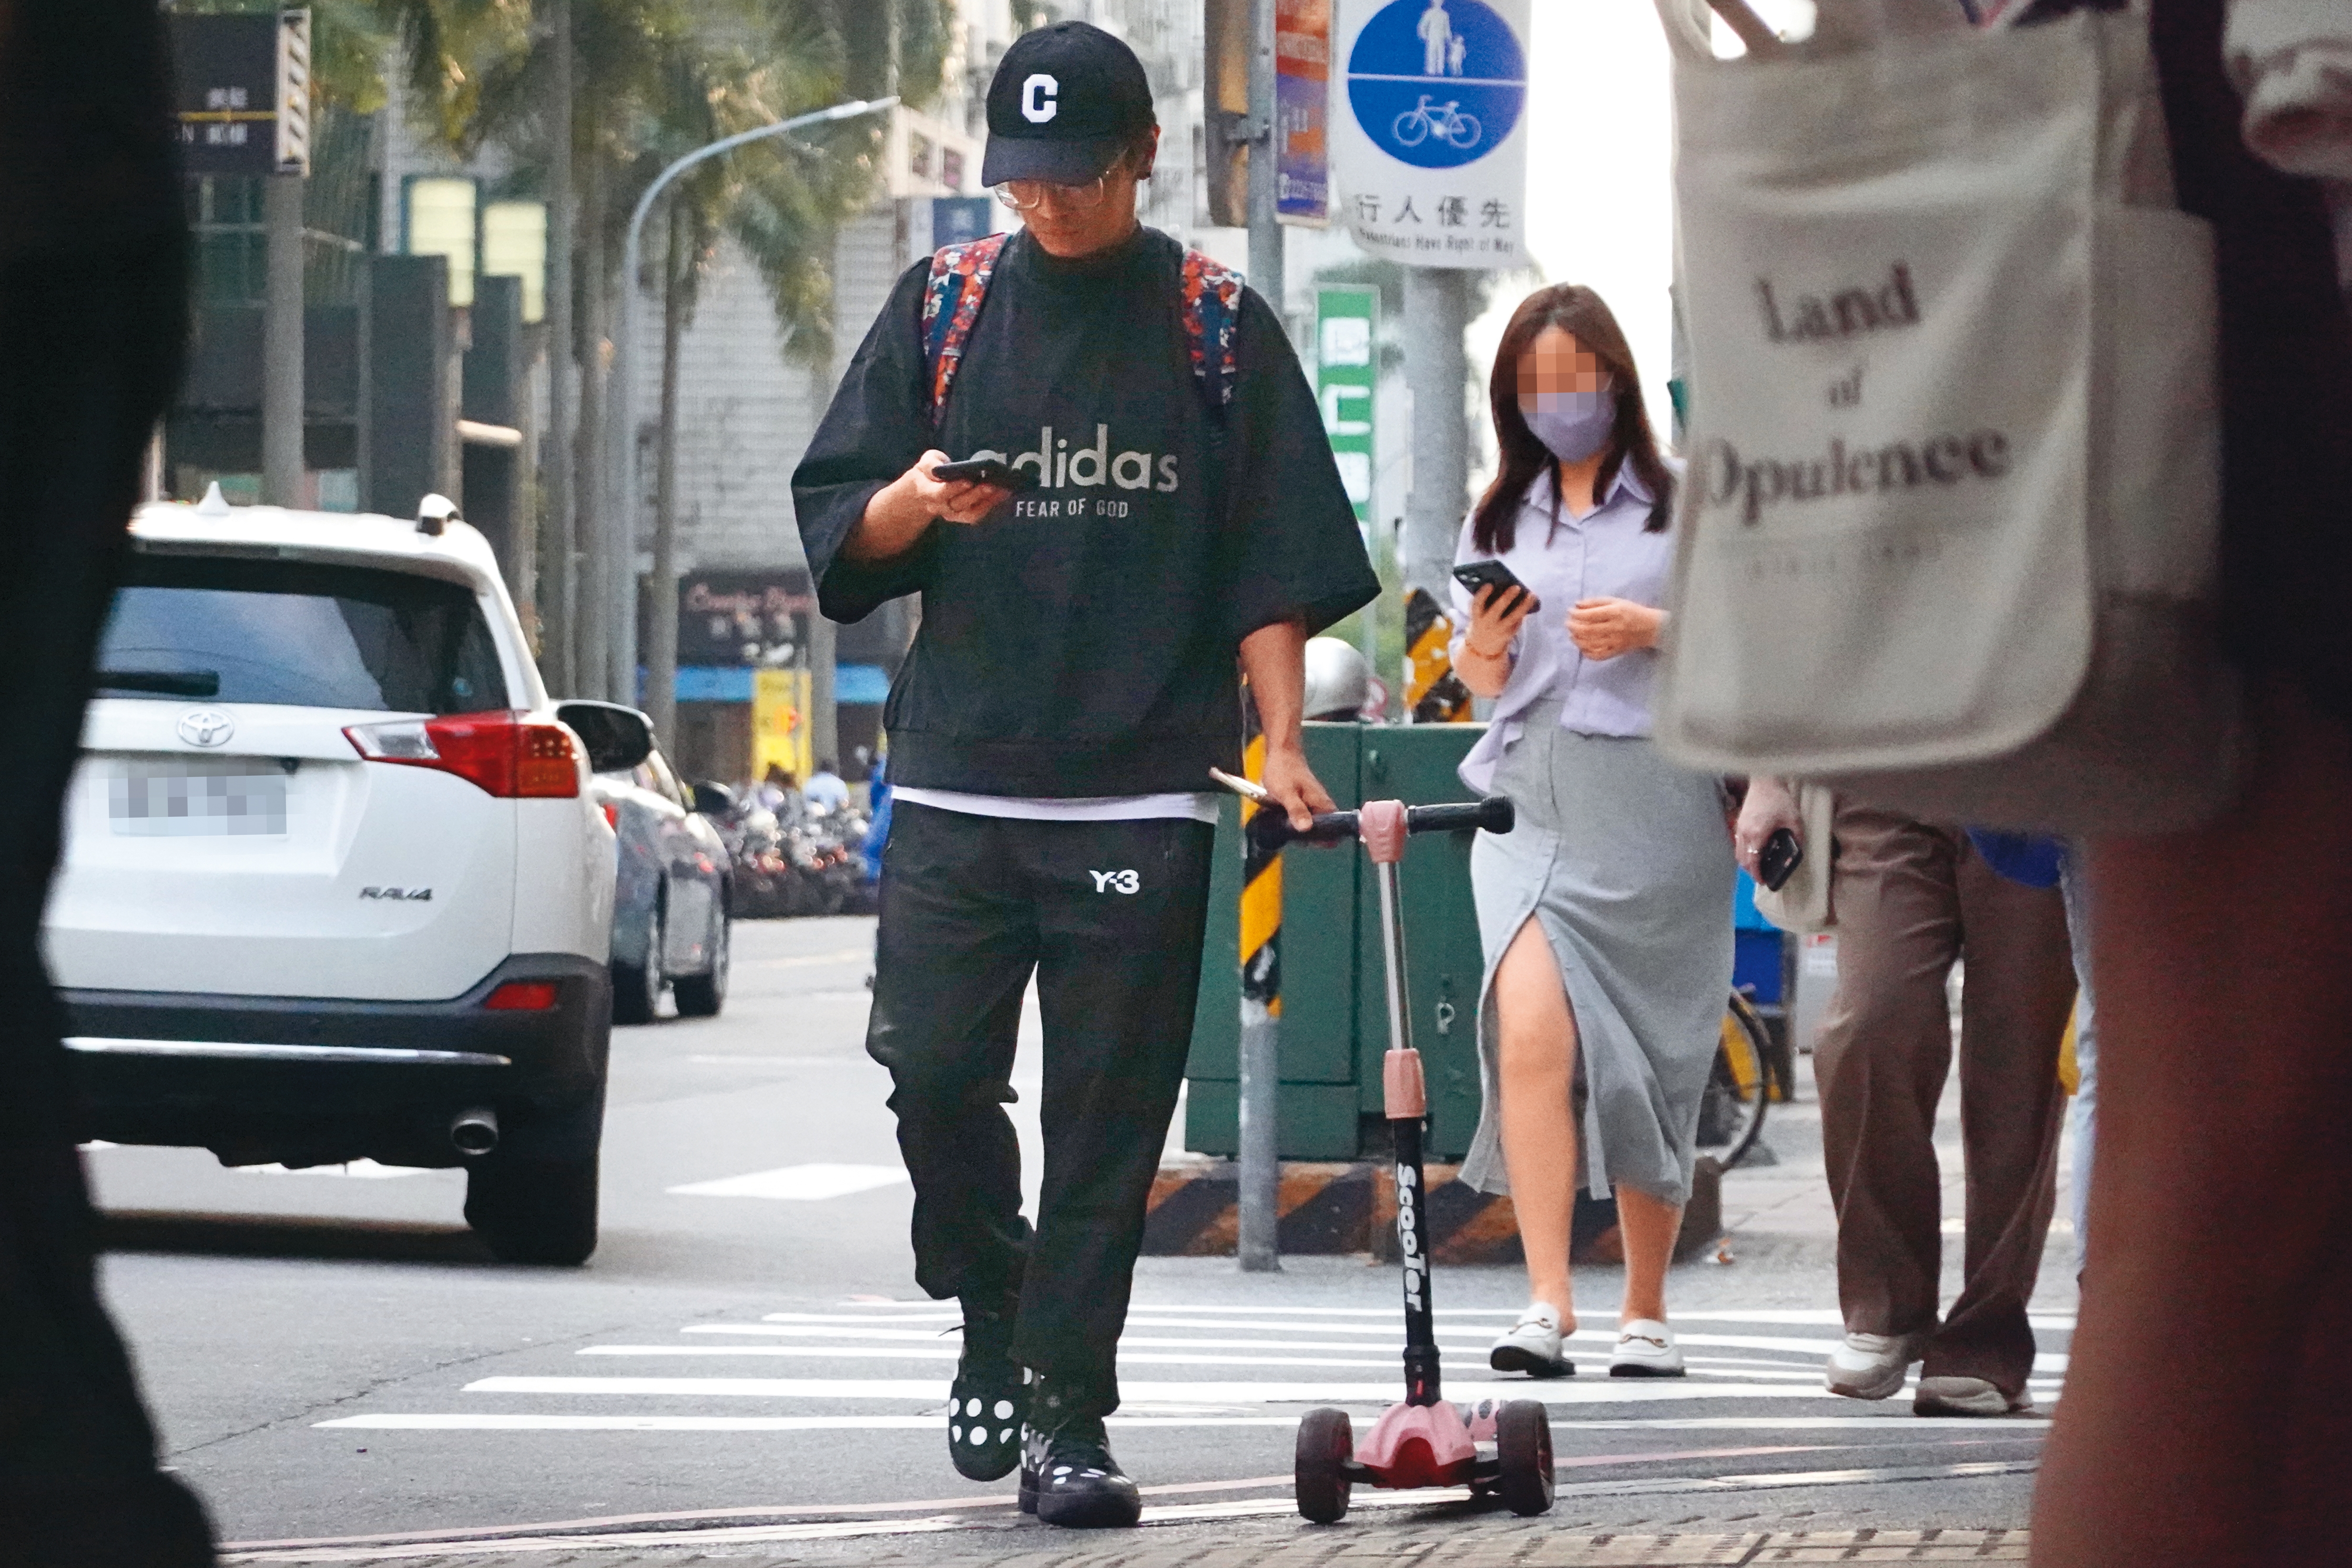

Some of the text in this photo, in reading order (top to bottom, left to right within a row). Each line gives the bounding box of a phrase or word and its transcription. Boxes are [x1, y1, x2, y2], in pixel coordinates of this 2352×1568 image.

[1022, 74, 1058, 122] C
[1355, 193, 1511, 228] 行人優先
[1754, 258, 1921, 345] Land
[1015, 498, 1129, 518] FEAR OF GOD
[358, 886, 433, 901] RAV4
[1089, 869, 1140, 894] Y-3
